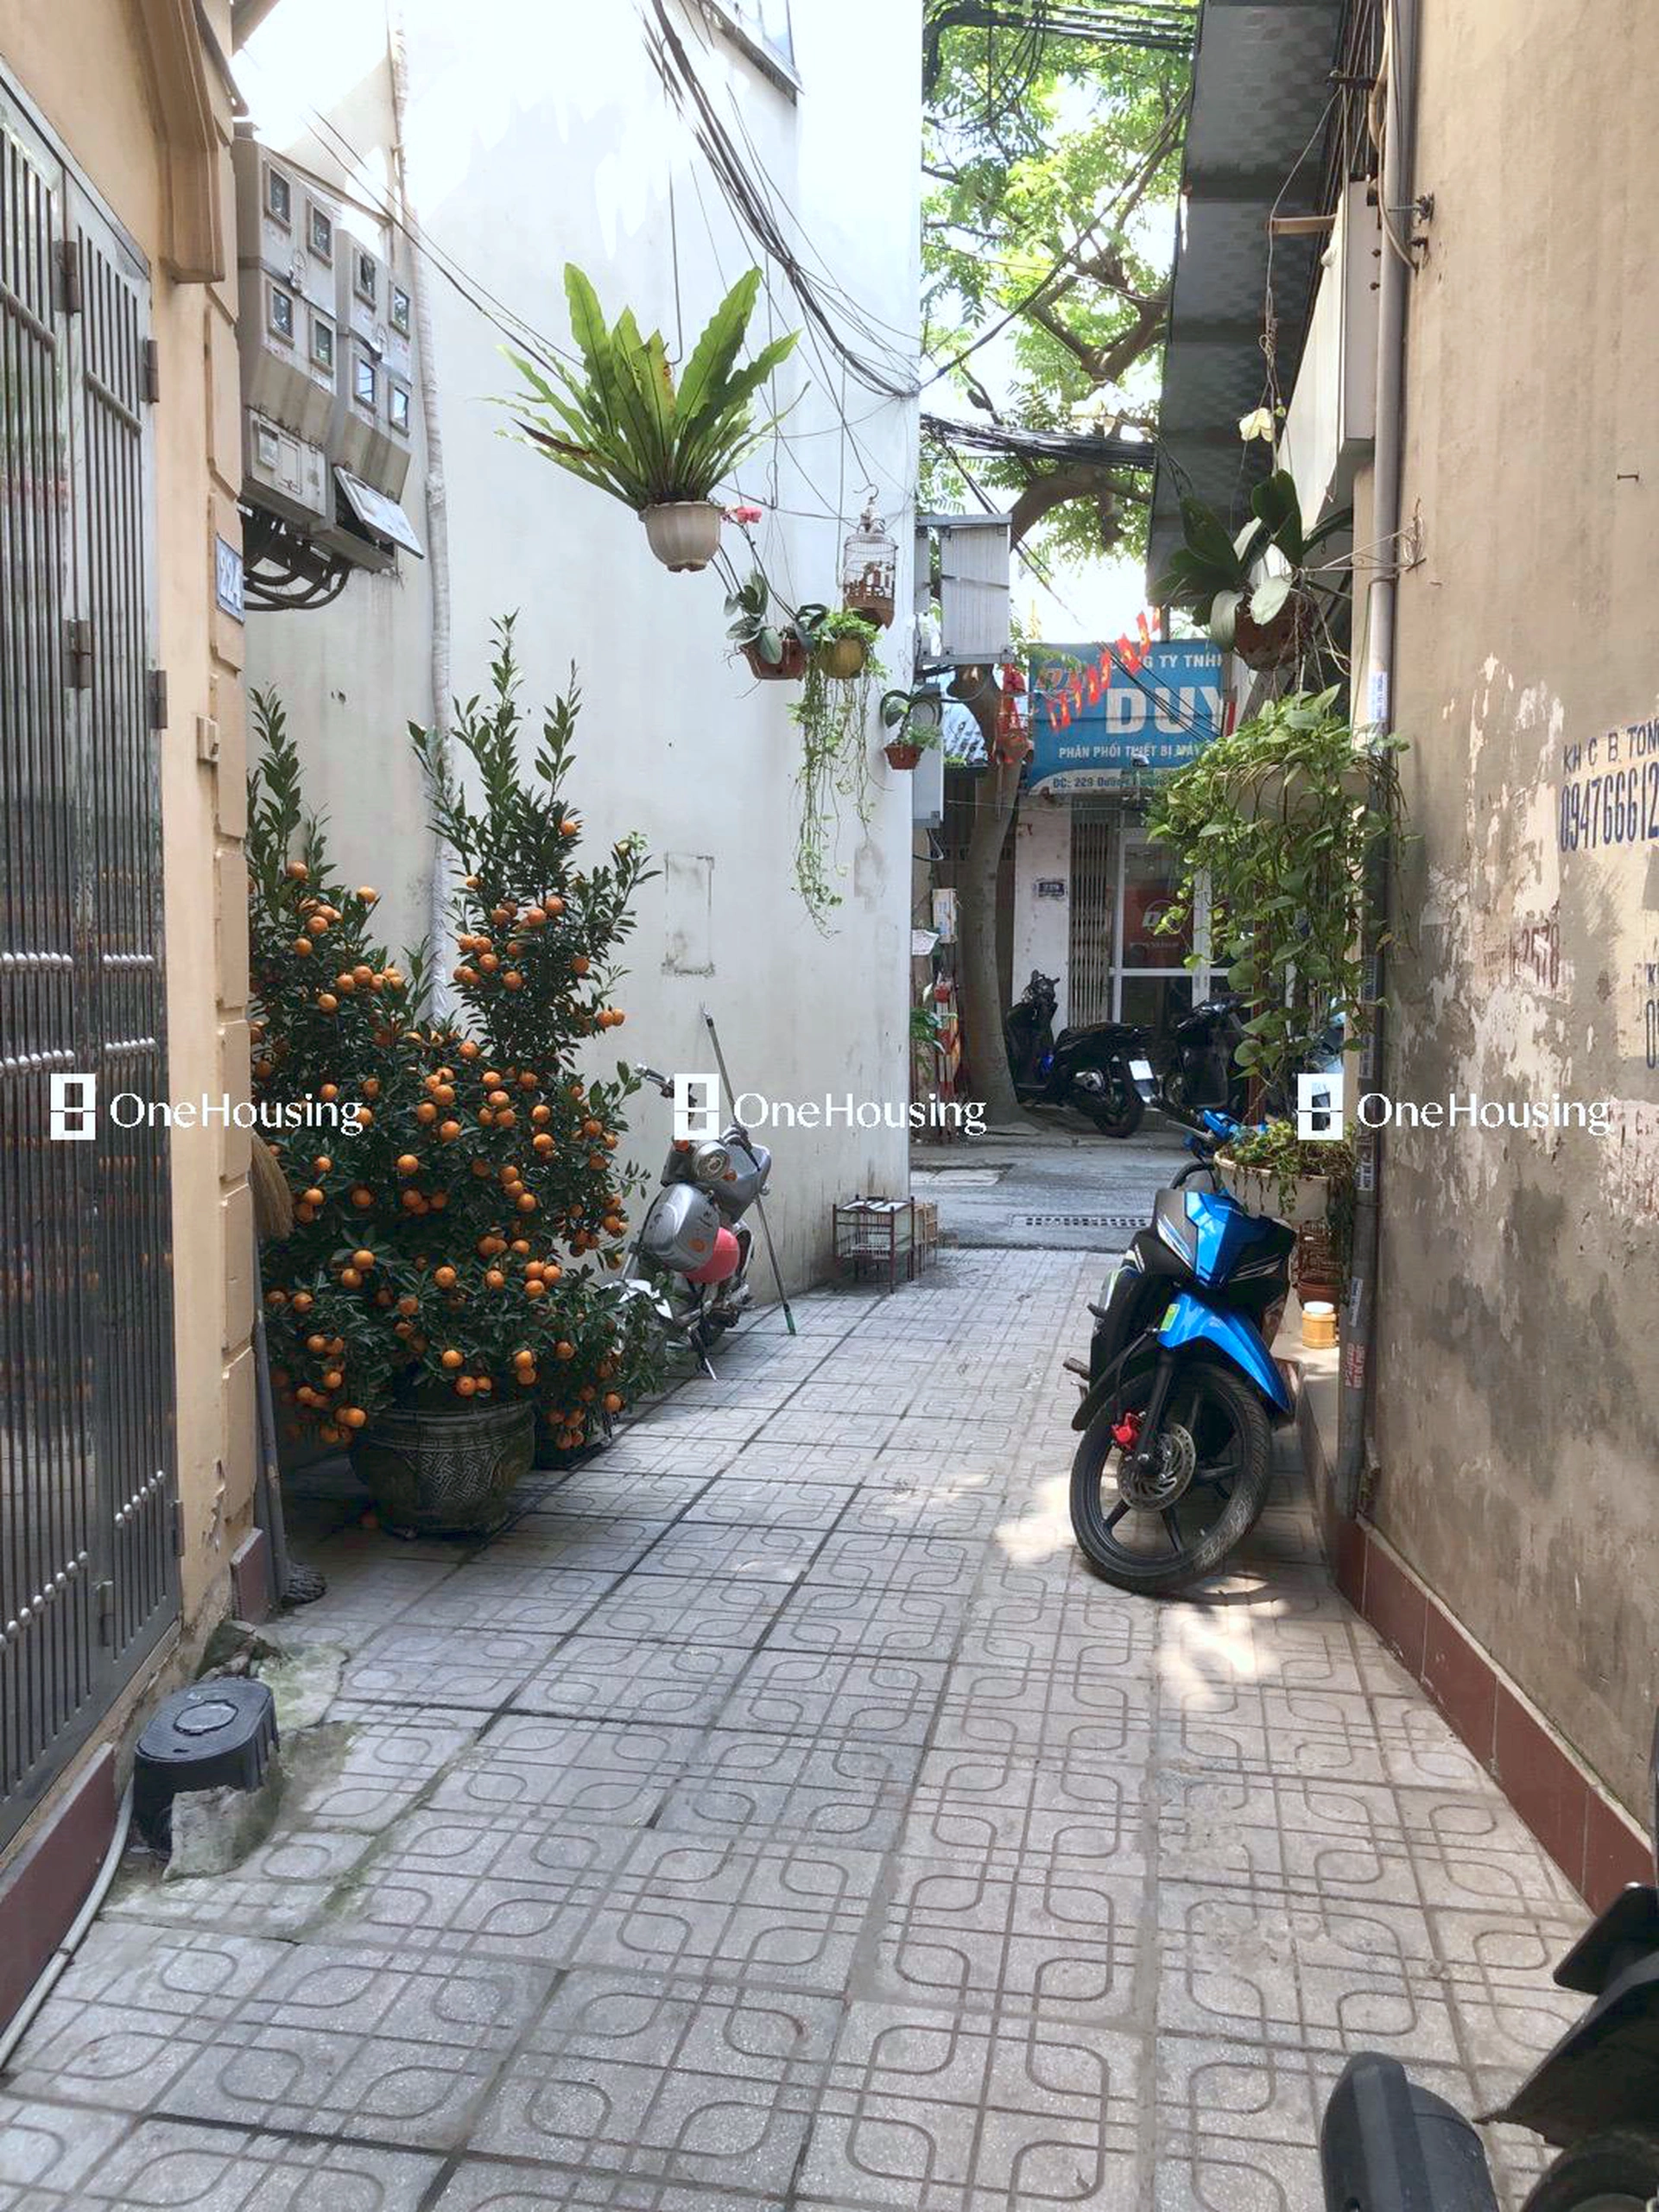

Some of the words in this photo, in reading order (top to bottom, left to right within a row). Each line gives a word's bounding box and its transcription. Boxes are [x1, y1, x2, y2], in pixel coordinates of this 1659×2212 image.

[1158, 654, 1178, 669] TY
[1626, 718, 1659, 760] TON
[1058, 744, 1090, 759] PHÂN
[1092, 740, 1121, 758] PHỐI
[1074, 776, 1093, 788] 229
